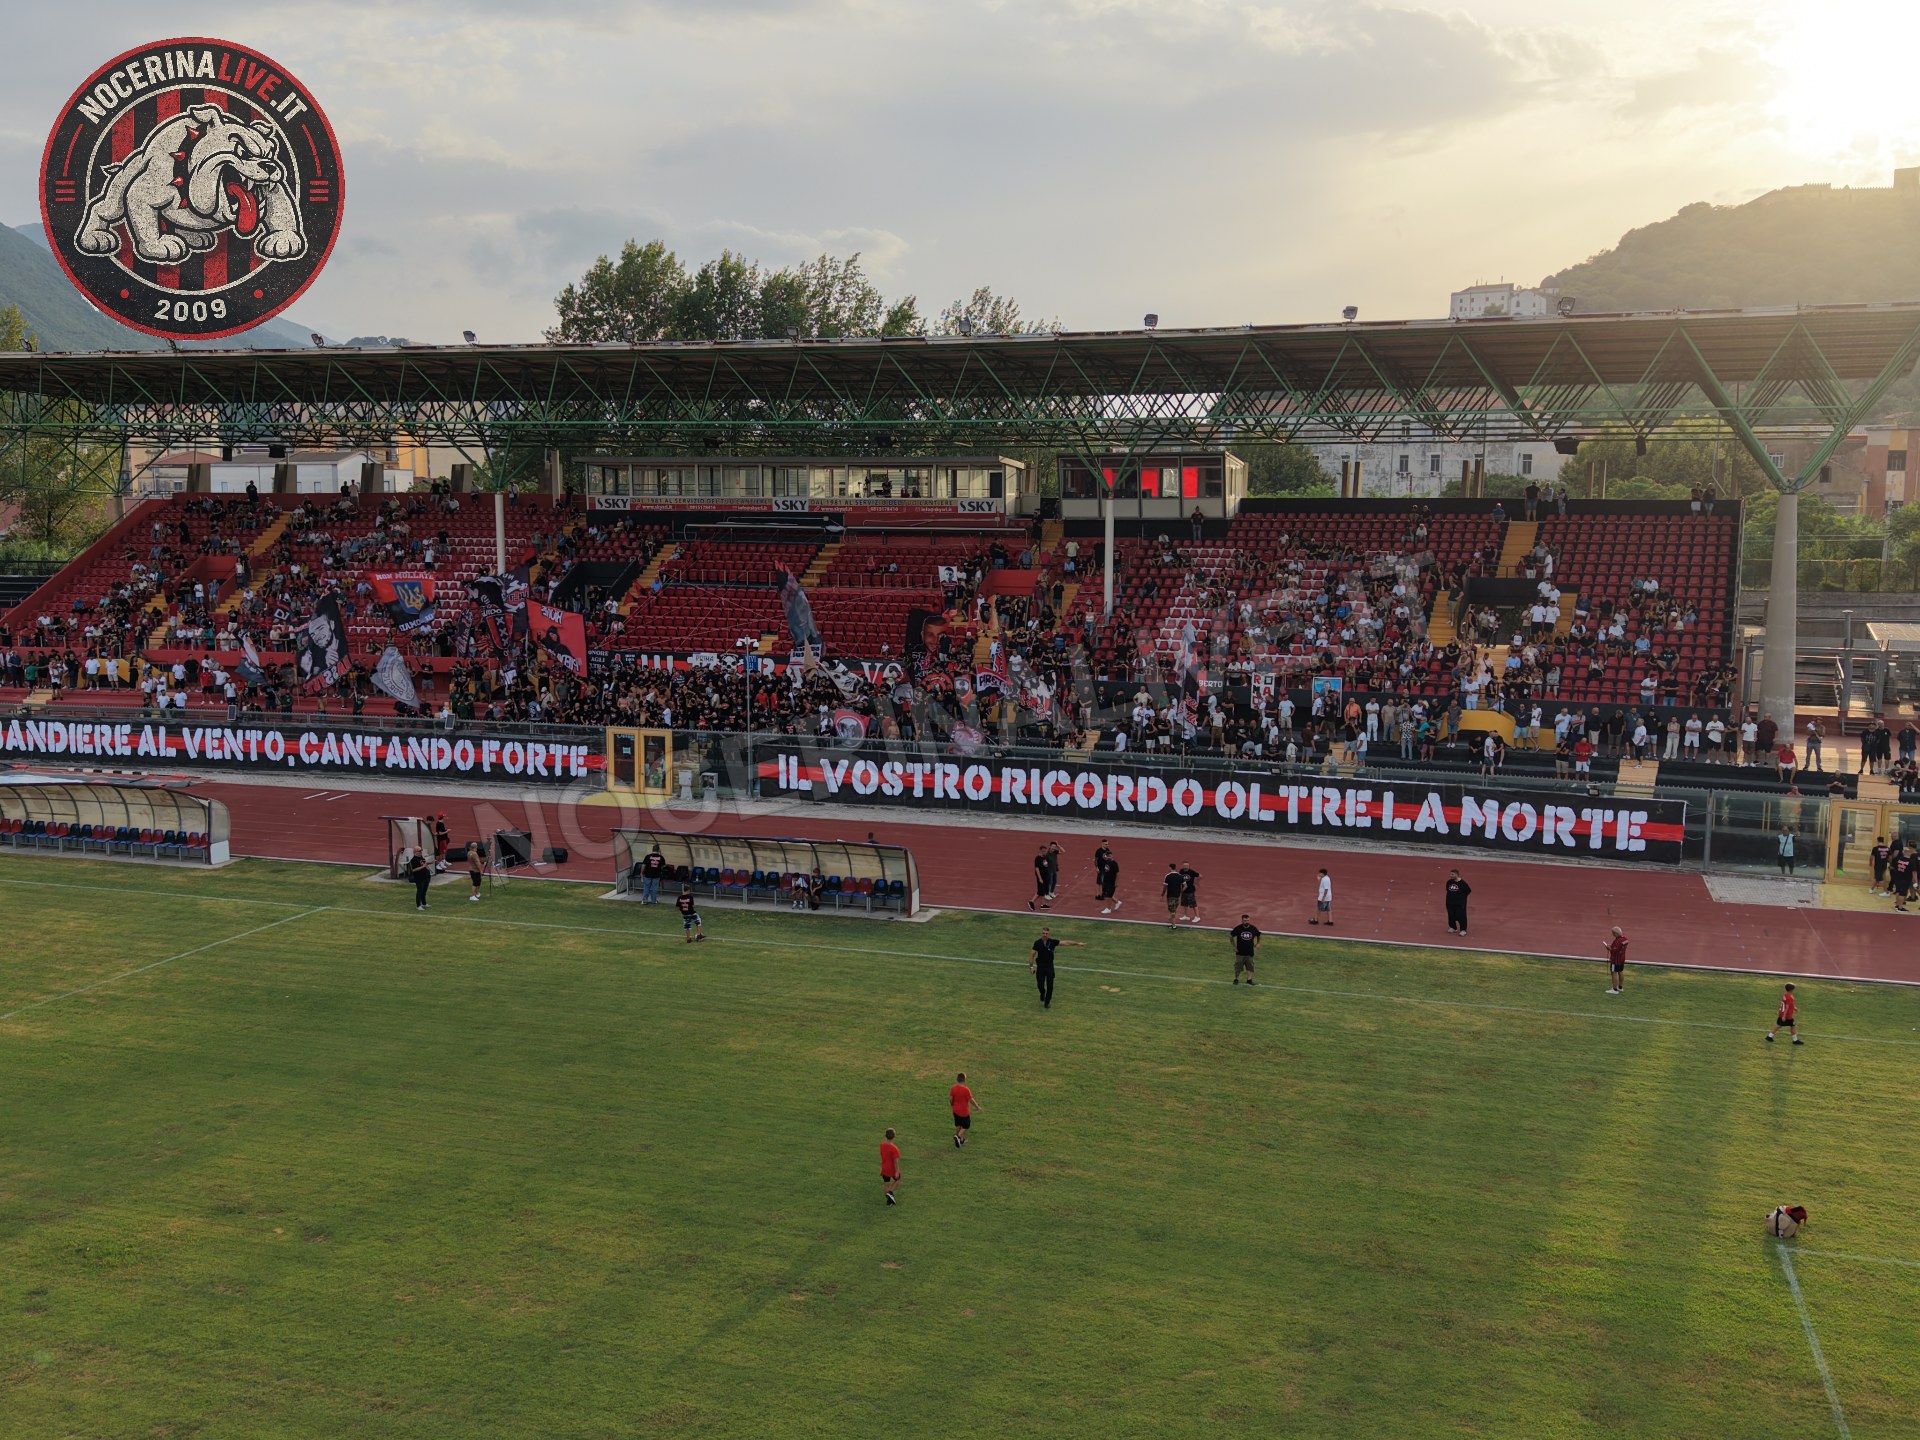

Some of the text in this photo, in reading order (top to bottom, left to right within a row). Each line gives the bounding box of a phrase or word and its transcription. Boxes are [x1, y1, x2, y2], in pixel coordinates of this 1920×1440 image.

[604, 498, 628, 509] SKY
[781, 499, 808, 511] SKY
[967, 501, 994, 512] SKY
[137, 724, 176, 757] AL
[182, 727, 295, 767] VENTO,
[300, 731, 475, 771] CANTANDO
[482, 740, 588, 777] FORTE
[777, 753, 1648, 852] IL VOSTRO RICORDO OLTRE LA MORTE
